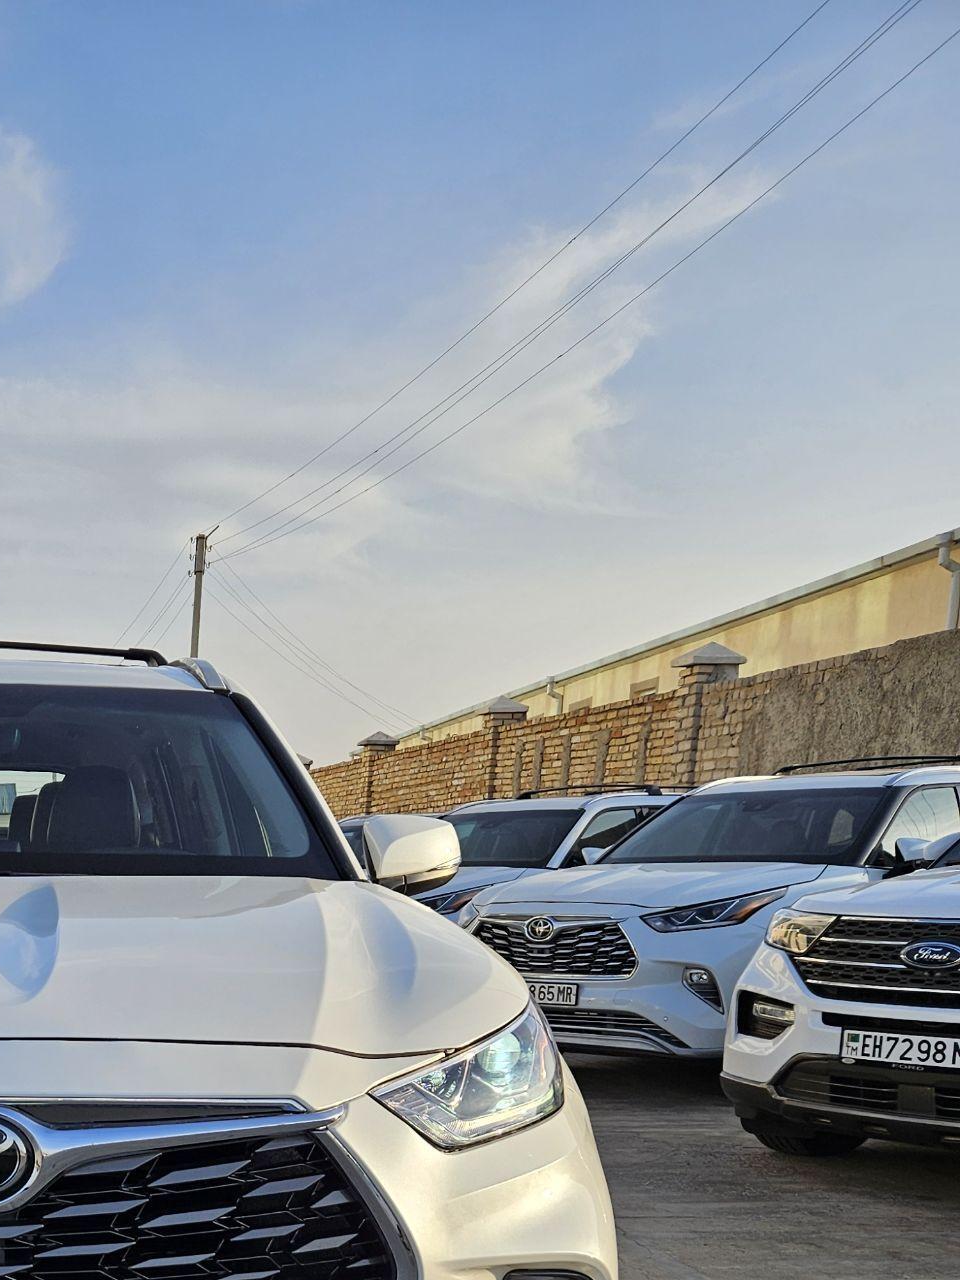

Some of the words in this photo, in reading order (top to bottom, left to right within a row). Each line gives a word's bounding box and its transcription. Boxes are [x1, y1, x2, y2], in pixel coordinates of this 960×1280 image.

[914, 947, 950, 959] Ford
[846, 1045, 858, 1056] TM
[891, 1063, 925, 1071] FORD
